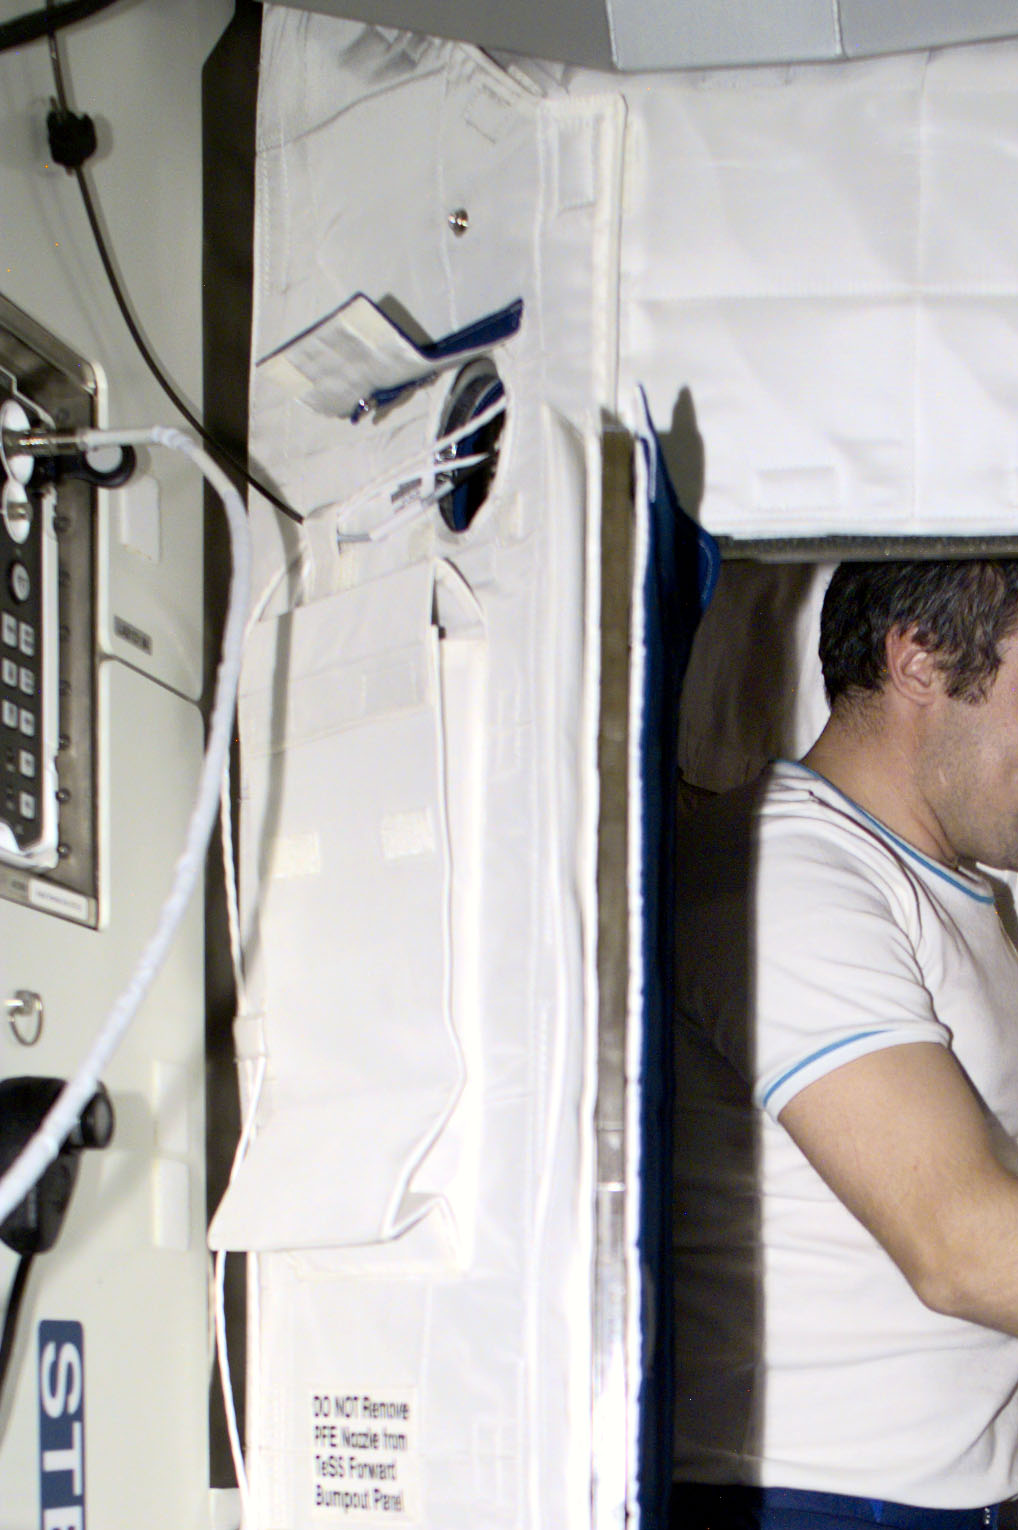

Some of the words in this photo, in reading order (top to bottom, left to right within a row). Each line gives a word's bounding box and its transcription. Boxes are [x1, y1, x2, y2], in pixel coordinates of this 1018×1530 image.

[314, 1395, 330, 1417] DO
[334, 1395, 358, 1418] NOT
[363, 1396, 409, 1420] Remove
